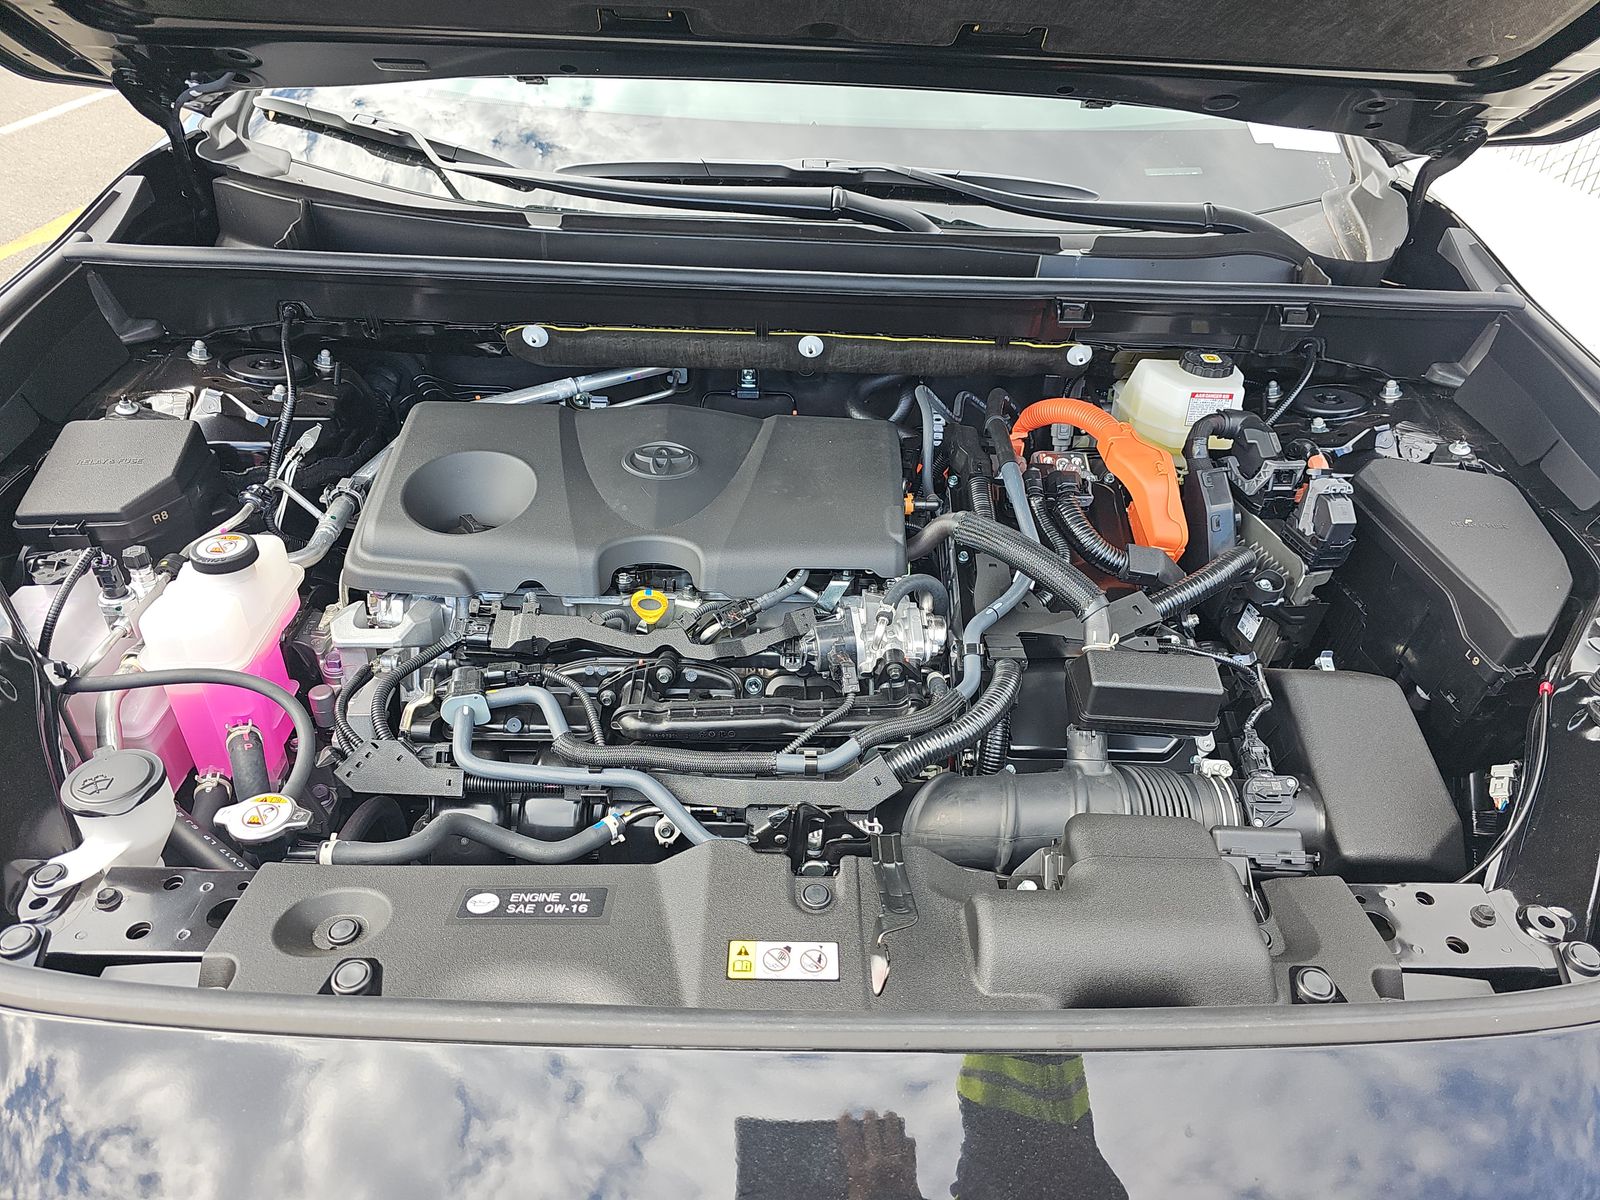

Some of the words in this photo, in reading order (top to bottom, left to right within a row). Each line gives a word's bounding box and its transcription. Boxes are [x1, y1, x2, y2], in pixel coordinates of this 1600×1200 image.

[152, 510, 169, 524] R8
[509, 892, 562, 902] ENGINE
[569, 892, 591, 902] OIL
[506, 904, 536, 914] SAE
[544, 904, 588, 914] 0W-16
